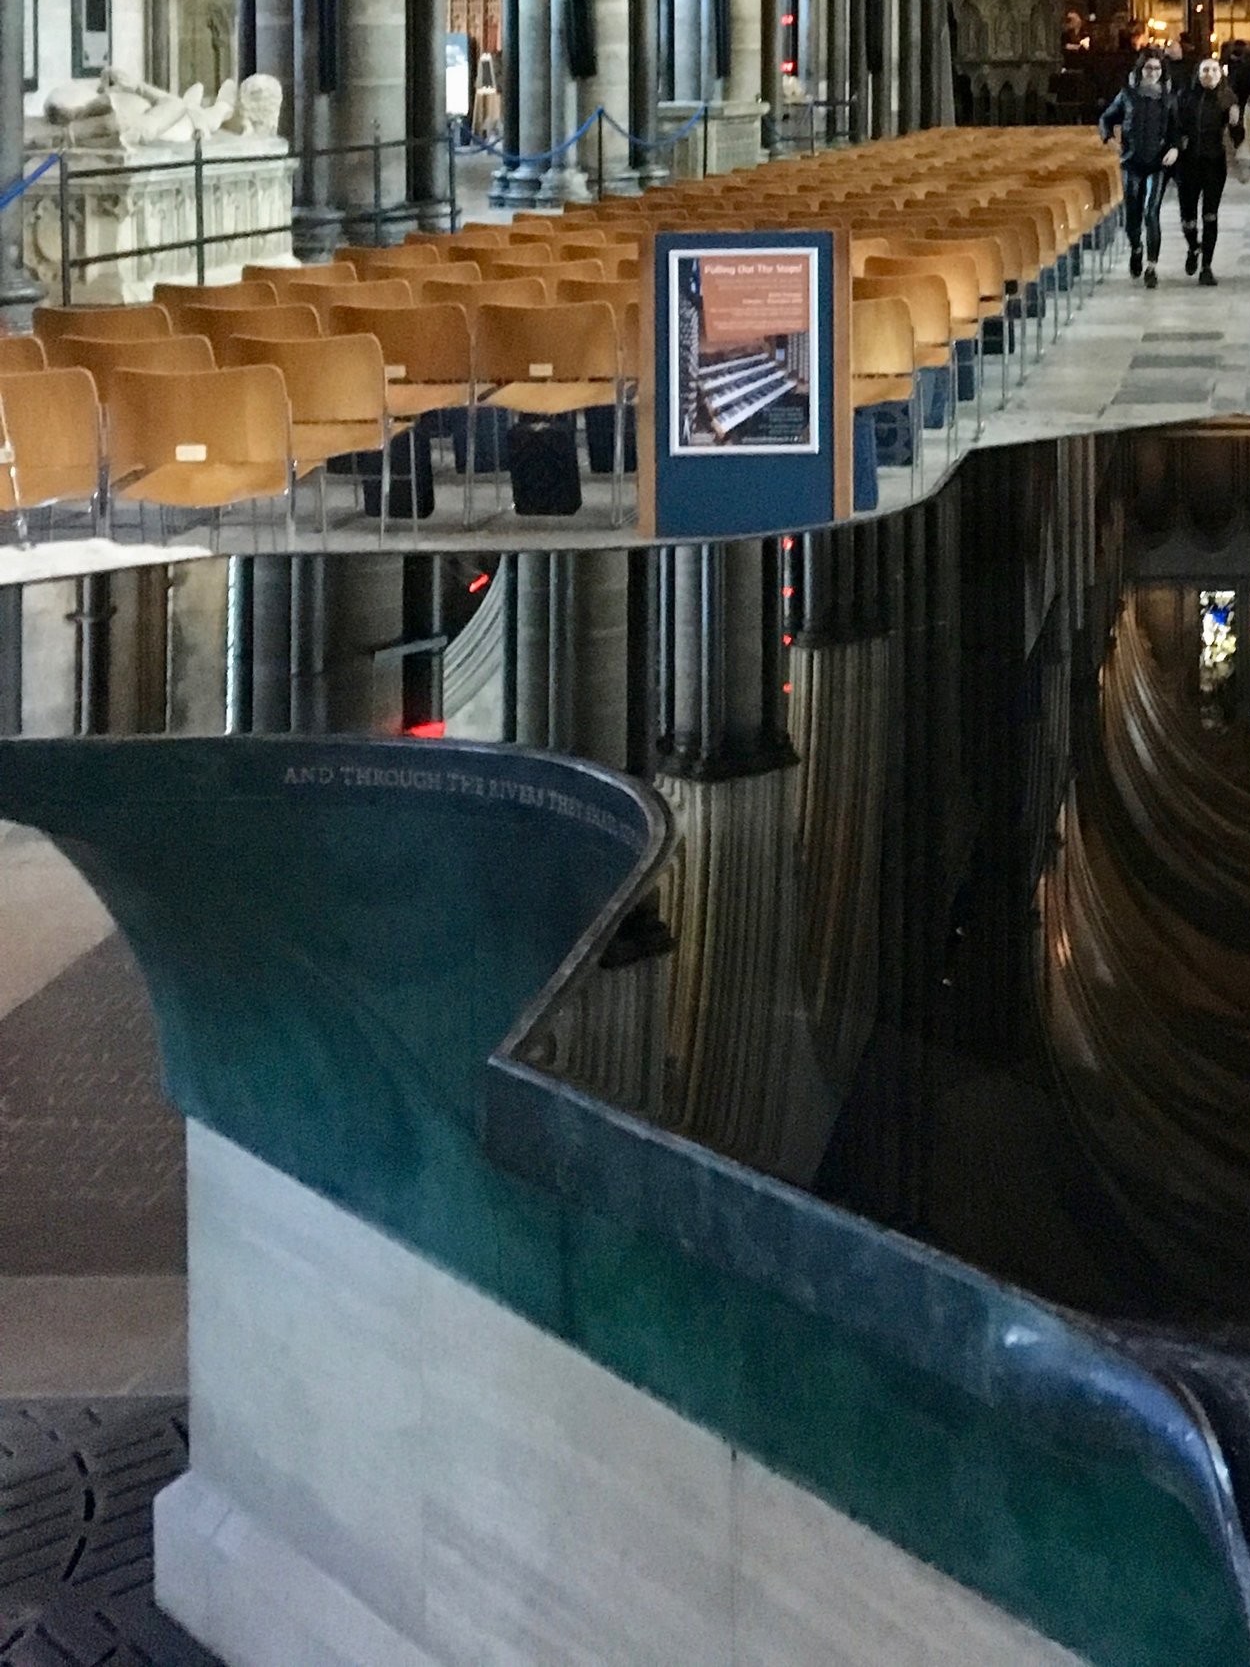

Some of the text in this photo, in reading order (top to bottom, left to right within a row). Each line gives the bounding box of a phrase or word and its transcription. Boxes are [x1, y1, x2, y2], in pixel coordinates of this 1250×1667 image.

[704, 264, 736, 276] Pulling
[737, 264, 755, 274] Out
[757, 264, 774, 274] The
[284, 766, 335, 785] AND
[339, 766, 442, 791] THROUGH
[447, 771, 484, 796] THE
